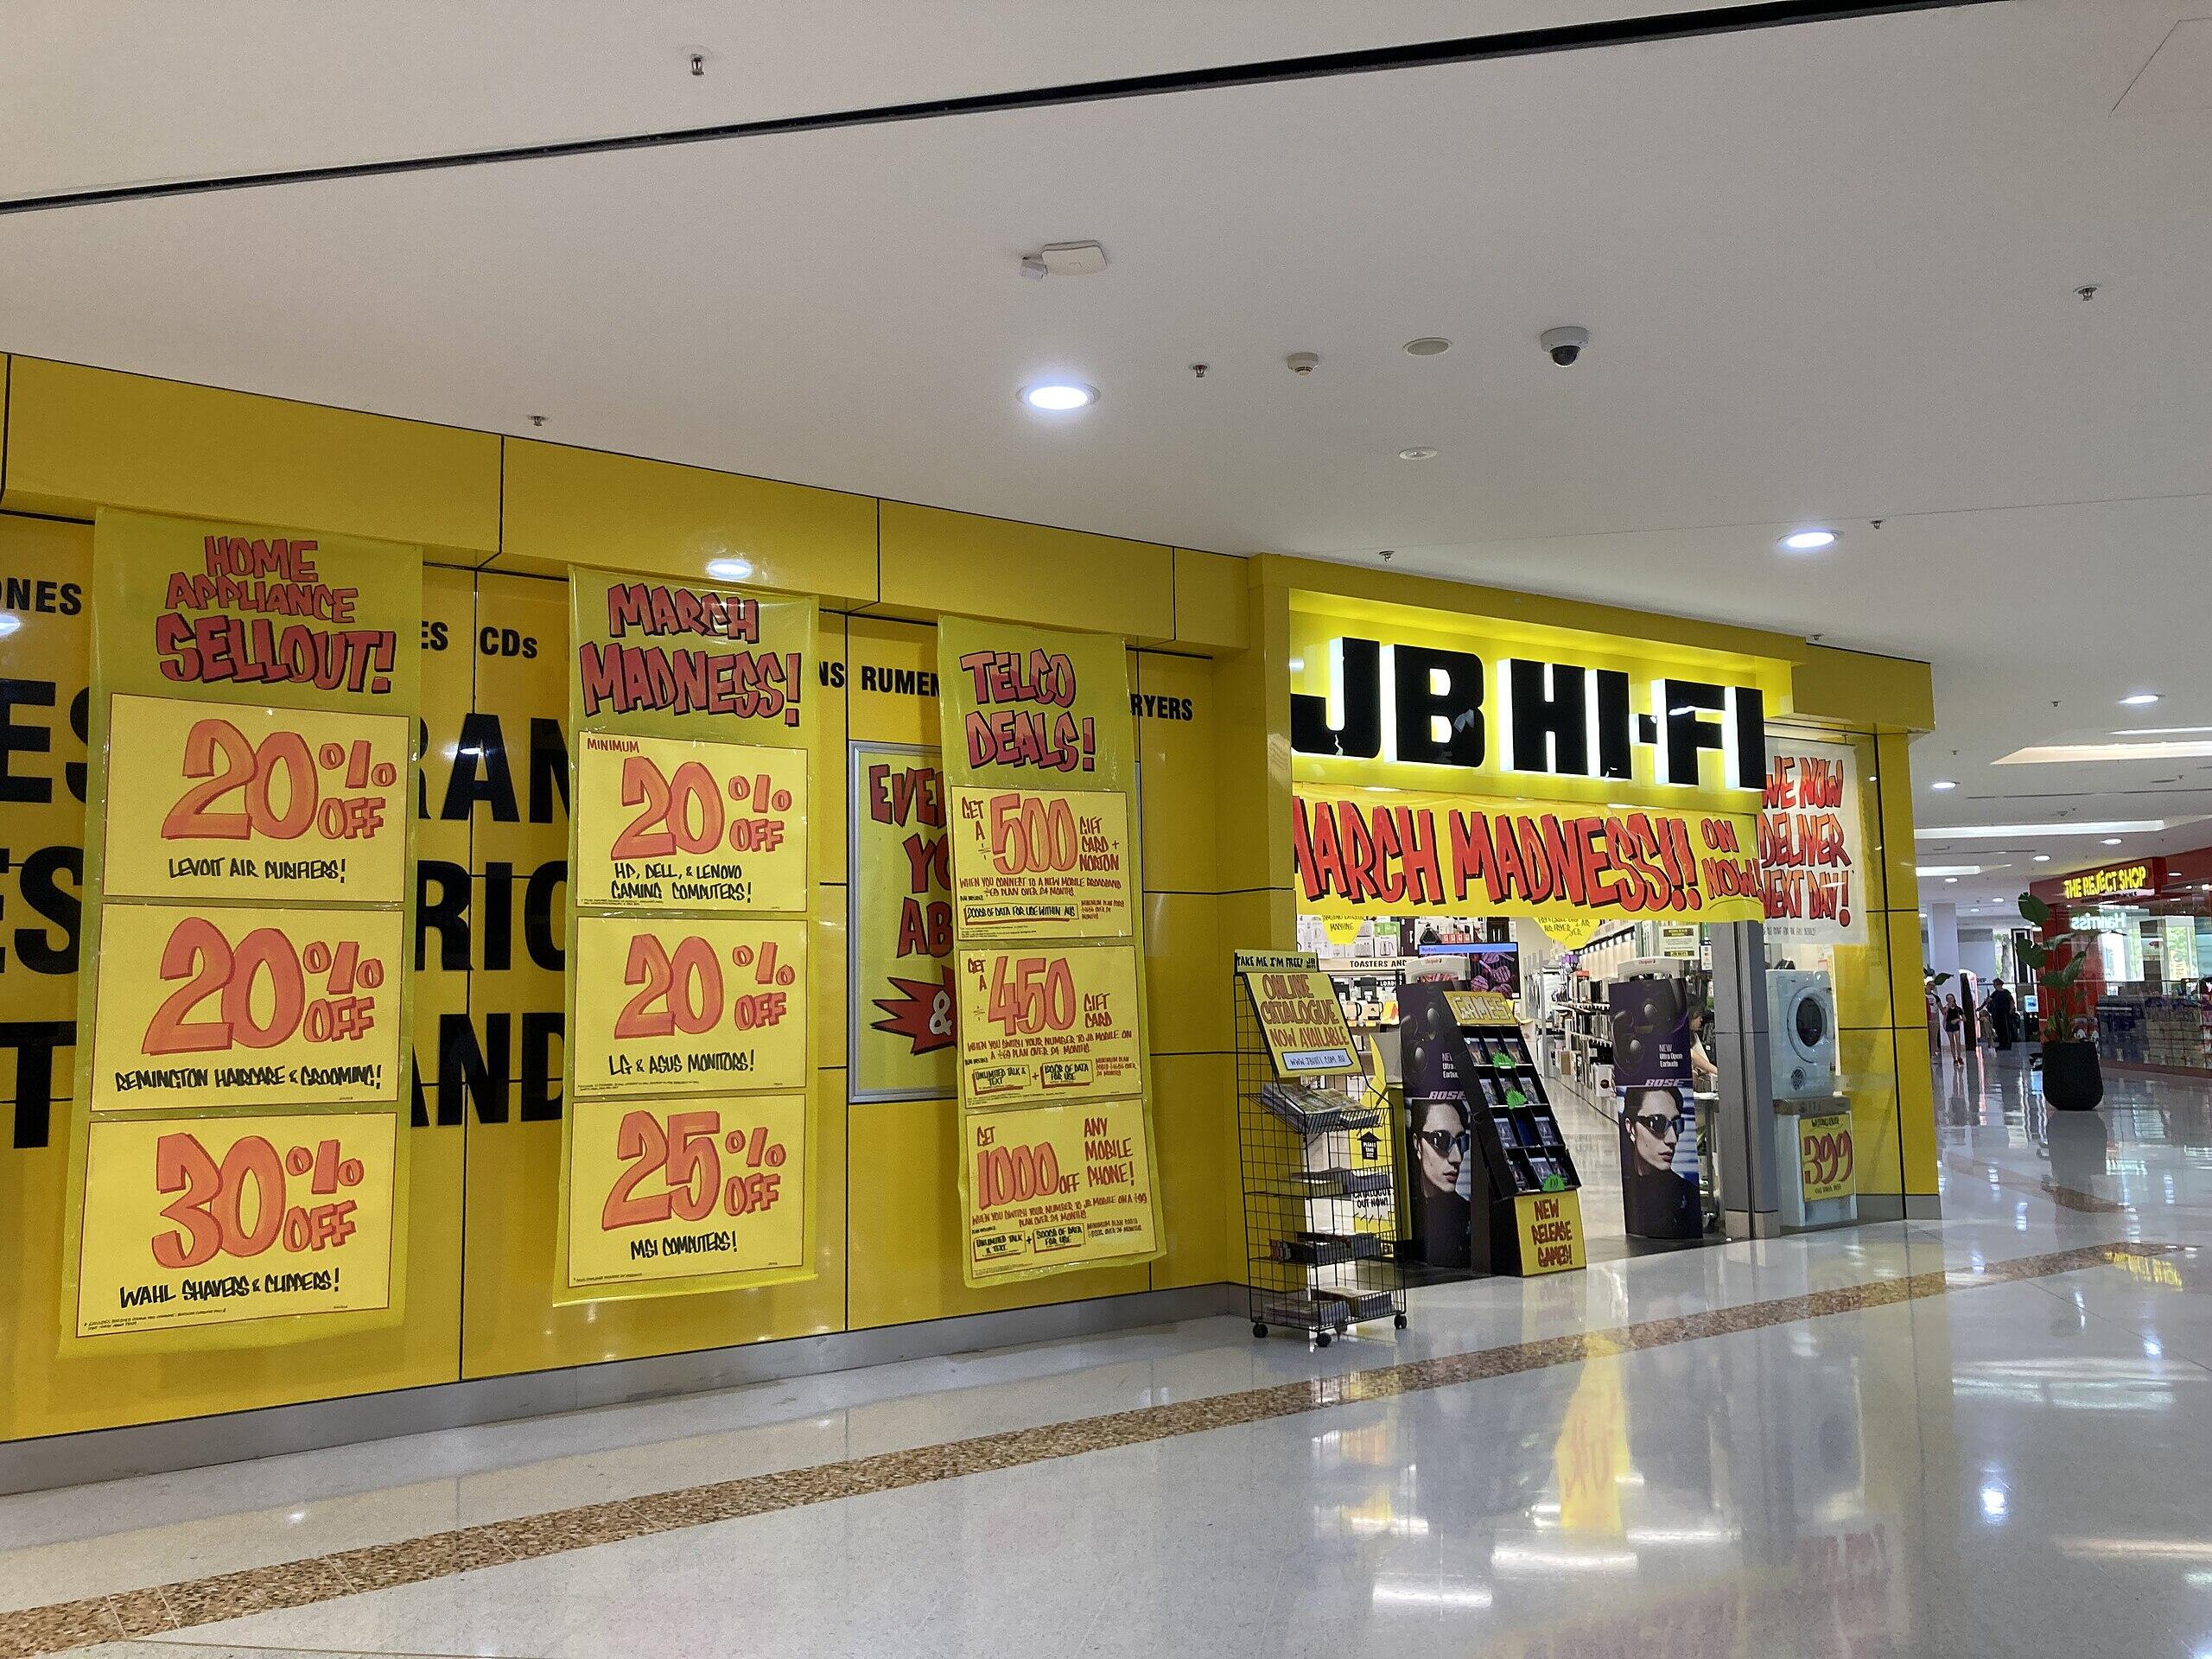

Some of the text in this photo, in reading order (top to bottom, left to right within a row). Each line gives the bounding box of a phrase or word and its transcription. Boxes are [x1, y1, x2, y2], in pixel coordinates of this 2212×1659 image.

[205, 536, 318, 582] HOME
[0, 576, 82, 616] NES
[165, 571, 358, 623] APPLIANCE
[607, 582, 760, 644] MARCH
[156, 613, 397, 694] SELLOUT!
[480, 626, 537, 659] CDs
[579, 642, 801, 728] MADNESS!
[960, 648, 1076, 709] TELCO
[1291, 636, 1767, 791] JB HI-FI
[587, 738, 639, 753] MINIMUM
[965, 709, 1096, 772] DEALS!
[161, 719, 397, 840] 20%
[1763, 755, 1843, 810] WE NOW
[317, 797, 386, 839] OFF
[610, 755, 792, 861] 20%
[962, 797, 984, 819] GET
[729, 818, 785, 853] OFF
[975, 821, 986, 841] A
[1079, 816, 1102, 836] GIFT
[1700, 817, 1738, 853] ON
[1082, 836, 1109, 853] CARD
[1756, 812, 1852, 868] DELIVER
[168, 856, 346, 884] LEVOIT AIR PURIFIERS!
[645, 862, 682, 880] DELL,
[685, 865, 693, 877] &
[696, 864, 742, 880] LENOVO
[1079, 854, 1120, 872] NORTON
[1448, 810, 1703, 913] MADNESS!!
[960, 877, 1122, 889] WHEN YOU CONNECT TO A NEW MOBILE BROADBAND
[1702, 856, 1764, 899] NOW!
[2063, 878, 2082, 899] THE
[2082, 869, 2117, 897] REJECT
[2119, 866, 2146, 890] SHOP
[611, 881, 752, 904] GAMING COMPUTERS!
[1001, 887, 1019, 896] PLAN
[1020, 887, 1038, 896] OVER
[1050, 887, 1075, 896] MONTHS
[1807, 870, 1851, 927] DAY!
[988, 907, 994, 916] OF
[995, 906, 1010, 916] DATA
[1012, 906, 1025, 916] FOR
[1026, 906, 1038, 916] USE
[1039, 906, 1060, 916] WITHIN
[1064, 906, 1075, 917] AUS
[968, 957, 987, 974] GET
[1237, 956, 1254, 967] TAKE
[1255, 957, 1268, 967] ME
[1269, 957, 1284, 968] I'M
[1286, 957, 1304, 968] FREE!
[141, 916, 385, 1056] 20%
[614, 933, 796, 1039] 20%
[979, 975, 987, 991] A
[1262, 974, 1314, 1000] ONLINE
[734, 992, 787, 1030] OFF
[1084, 992, 1110, 1013] GIFT
[1261, 999, 1339, 1025] CATALOGUE
[1452, 995, 1510, 1020] GAMES
[302, 996, 375, 1043] OFF
[1084, 1012, 1112, 1028] CARD
[967, 1030, 1132, 1052] WHEN YOU SWITCH YOUR NUMBER TO JB MOBILE ON
[1269, 1026, 1350, 1048] NOW AVAILABLE
[1659, 1044, 1673, 1052] NEW
[608, 1049, 754, 1076] LG & ASUS MONITORS!
[990, 1051, 996, 1059] A
[1013, 1048, 1028, 1058] PLAN
[1030, 1046, 1048, 1057] OVER
[1063, 1044, 1090, 1054] MONTHS
[115, 1065, 381, 1091] REMINGTON HAIRCARE & GROOMING!
[975, 1067, 1020, 1079] UNLIMITED TALK
[1051, 1072, 1063, 1081] FOR
[1065, 1064, 1073, 1073] OF
[1074, 1063, 1089, 1072] DATA
[988, 1077, 1003, 1086] TEXT
[976, 1126, 995, 1147] GET
[1084, 1117, 1108, 1138] ANY
[1084, 1137, 1134, 1161] MOBILE
[1803, 1129, 1853, 1185] 399
[601, 1109, 787, 1230] 25%
[977, 1141, 1080, 1211] 1000 OFF
[1087, 1161, 1135, 1187] PHONE!
[151, 1132, 364, 1268] 30%
[724, 1173, 780, 1216] OFF
[1357, 1198, 1389, 1208] OUT NOW!
[1534, 1198, 1560, 1221] NEW
[283, 1199, 359, 1252] OFF
[1531, 1221, 1573, 1245] RELEASE
[630, 1230, 737, 1260] MSI COMPUTERS!
[1536, 1244, 1573, 1268] GAMES!
[119, 1268, 340, 1308] WAHL SHAVERS & CLIPPERS!
